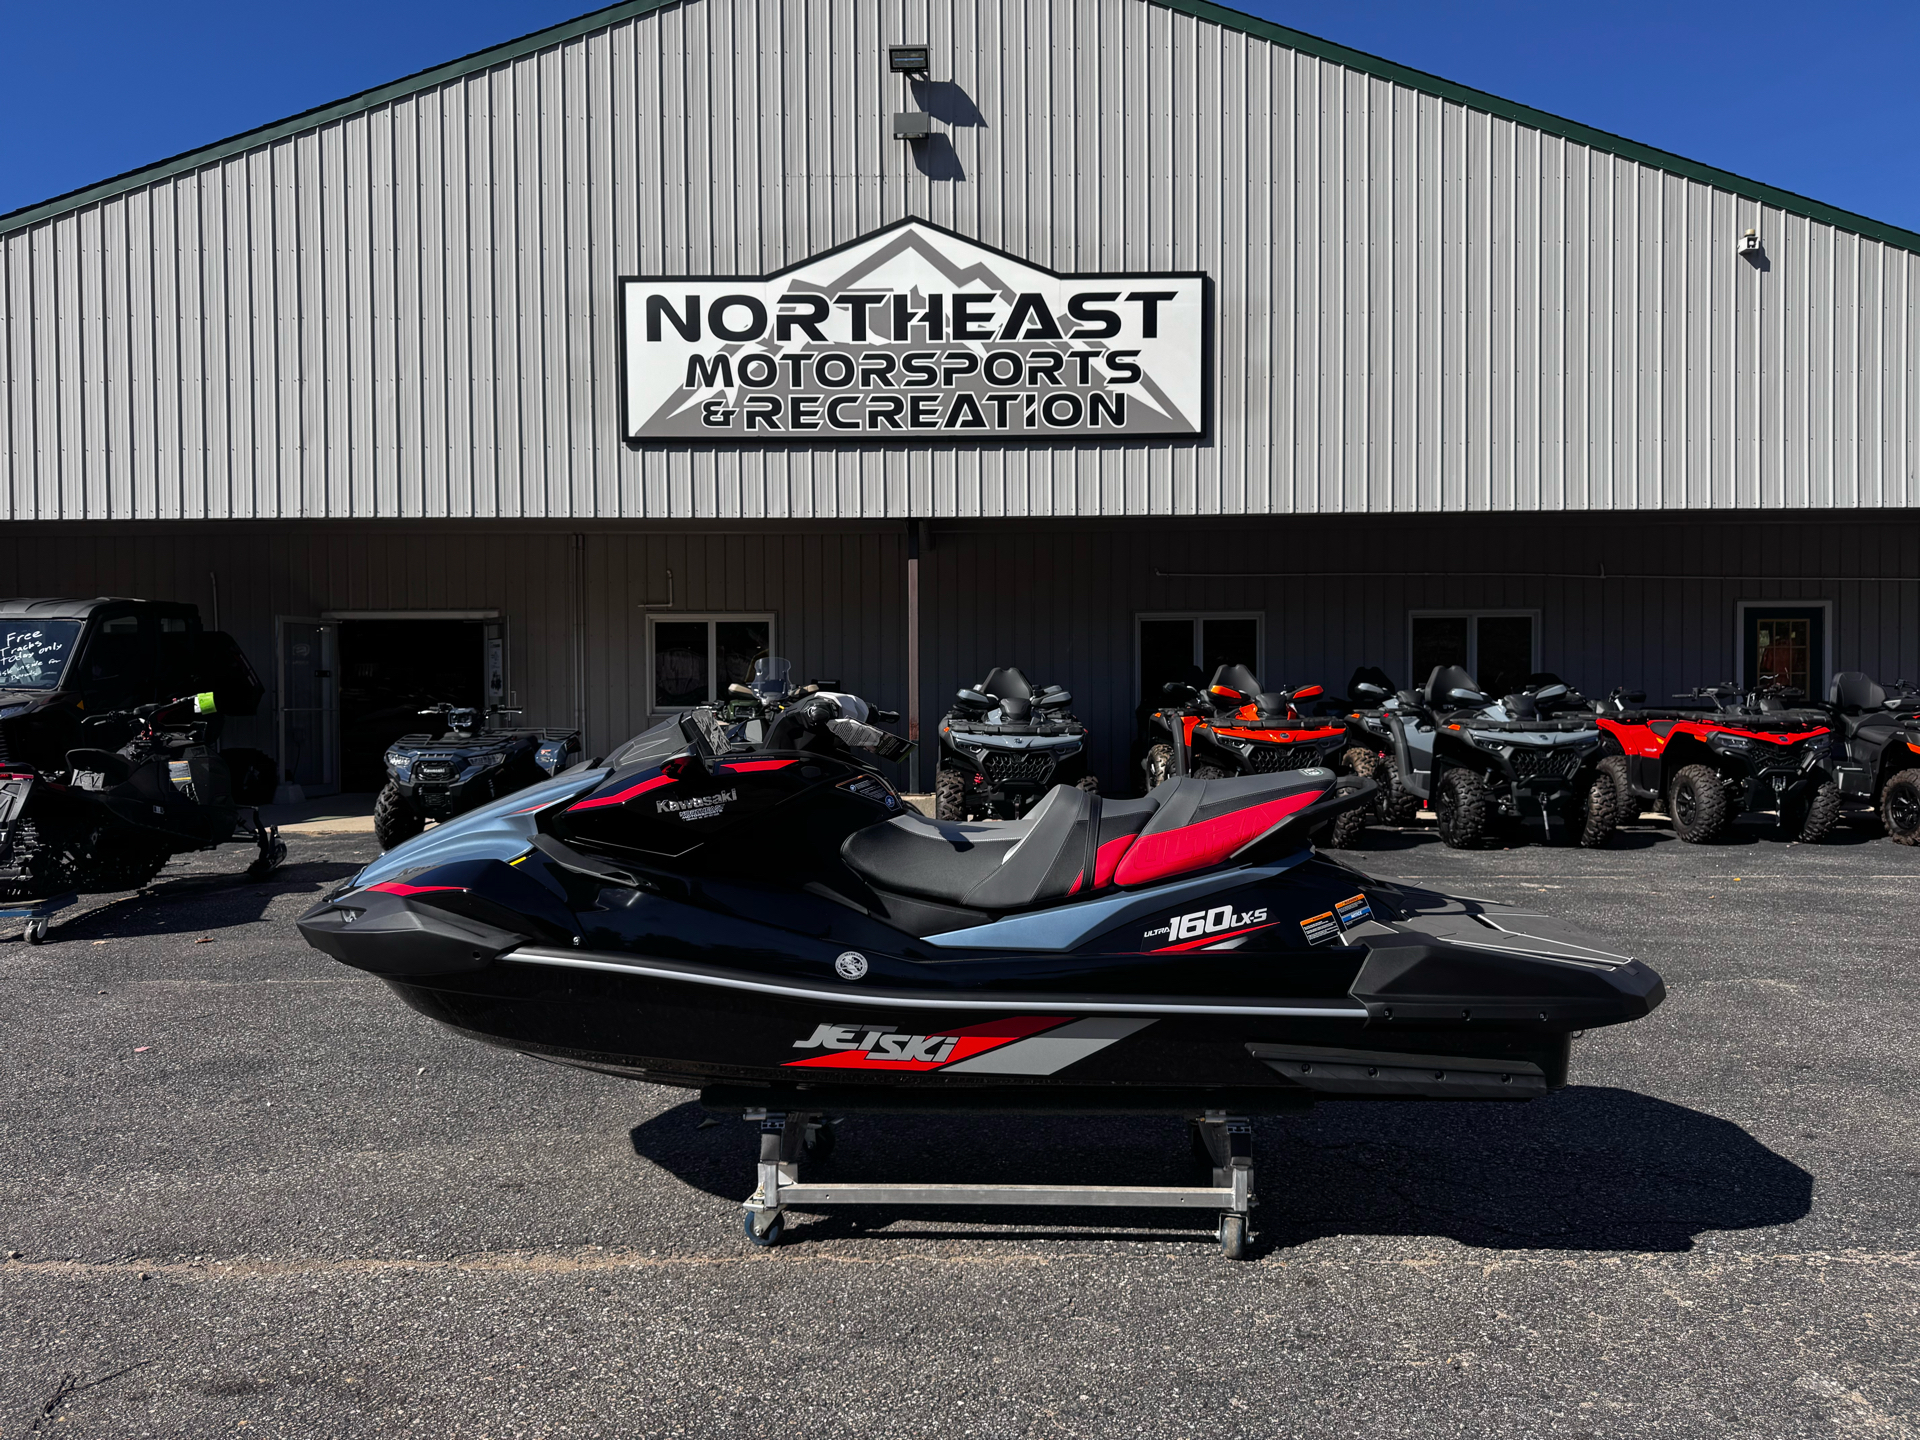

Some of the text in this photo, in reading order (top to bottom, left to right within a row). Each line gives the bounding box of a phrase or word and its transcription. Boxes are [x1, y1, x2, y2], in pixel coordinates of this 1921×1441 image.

[646, 291, 1179, 343] NORTHEAST
[685, 350, 1142, 388] MOTORSPORTS
[6, 631, 43, 647] Free
[38, 642, 62, 654] only
[656, 788, 738, 813] Kawasaki
[1143, 905, 1268, 942] ULTRA 160 LX-S
